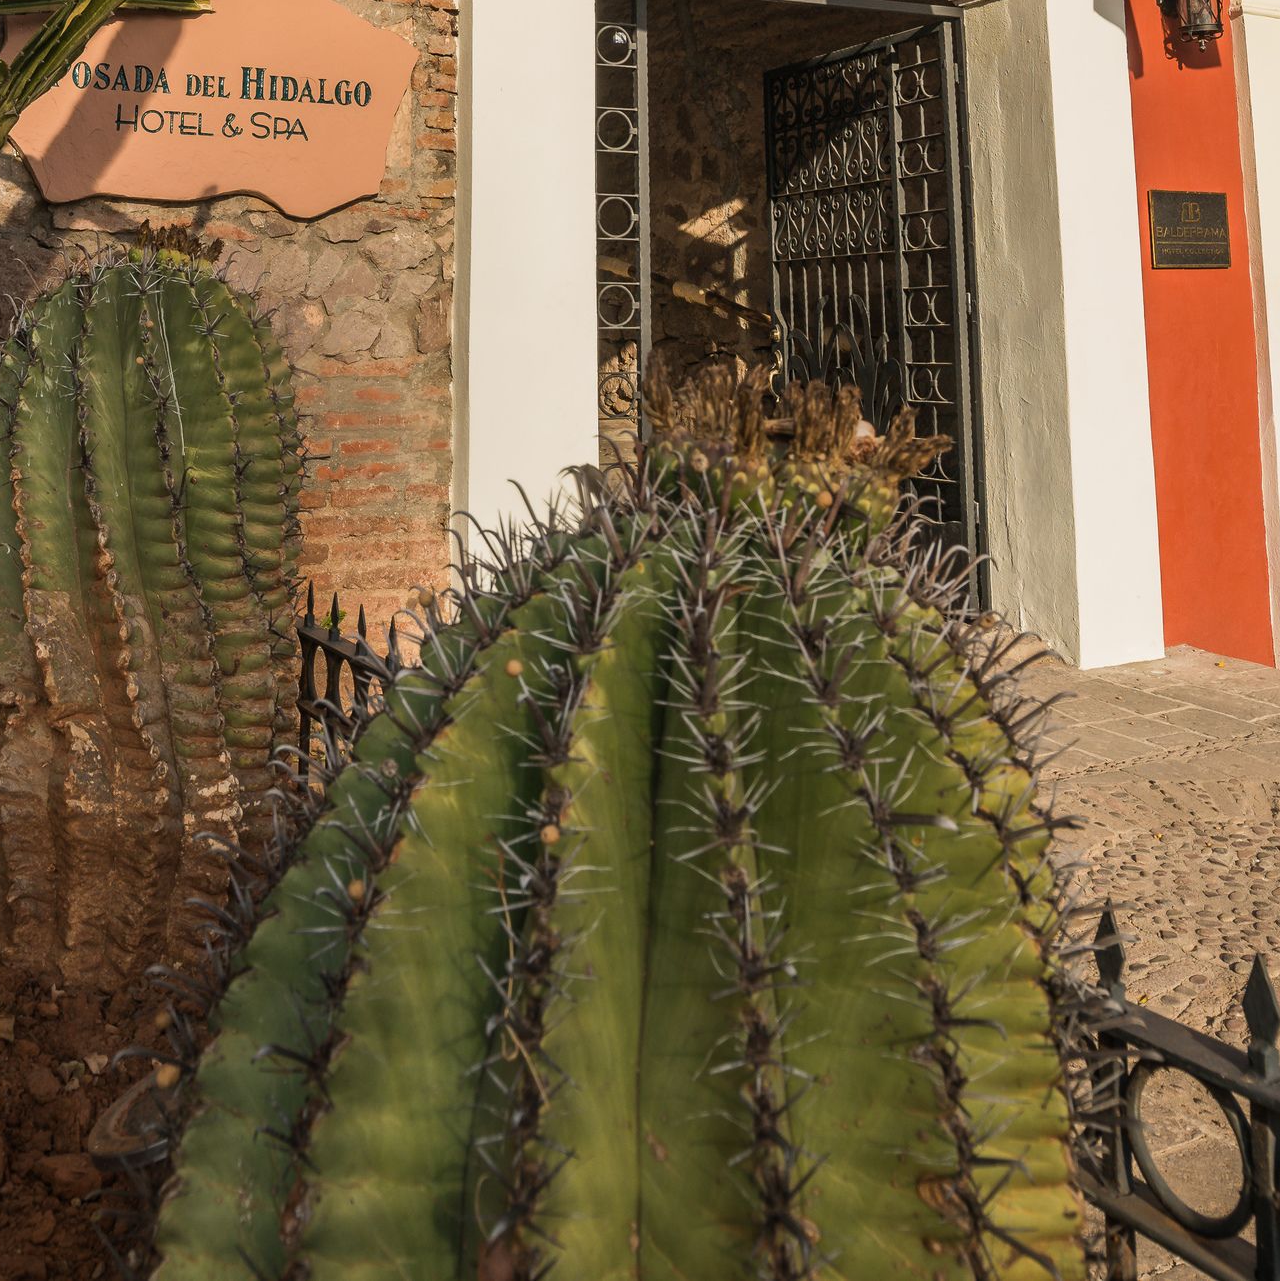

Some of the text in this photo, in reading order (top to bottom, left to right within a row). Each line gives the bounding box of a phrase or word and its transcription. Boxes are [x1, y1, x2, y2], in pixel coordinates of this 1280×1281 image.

[52, 61, 372, 107] OSADA DEL HIDALGO
[115, 104, 308, 141] HOTEL & SPA
[1156, 226, 1227, 238] BALDERRAMA
